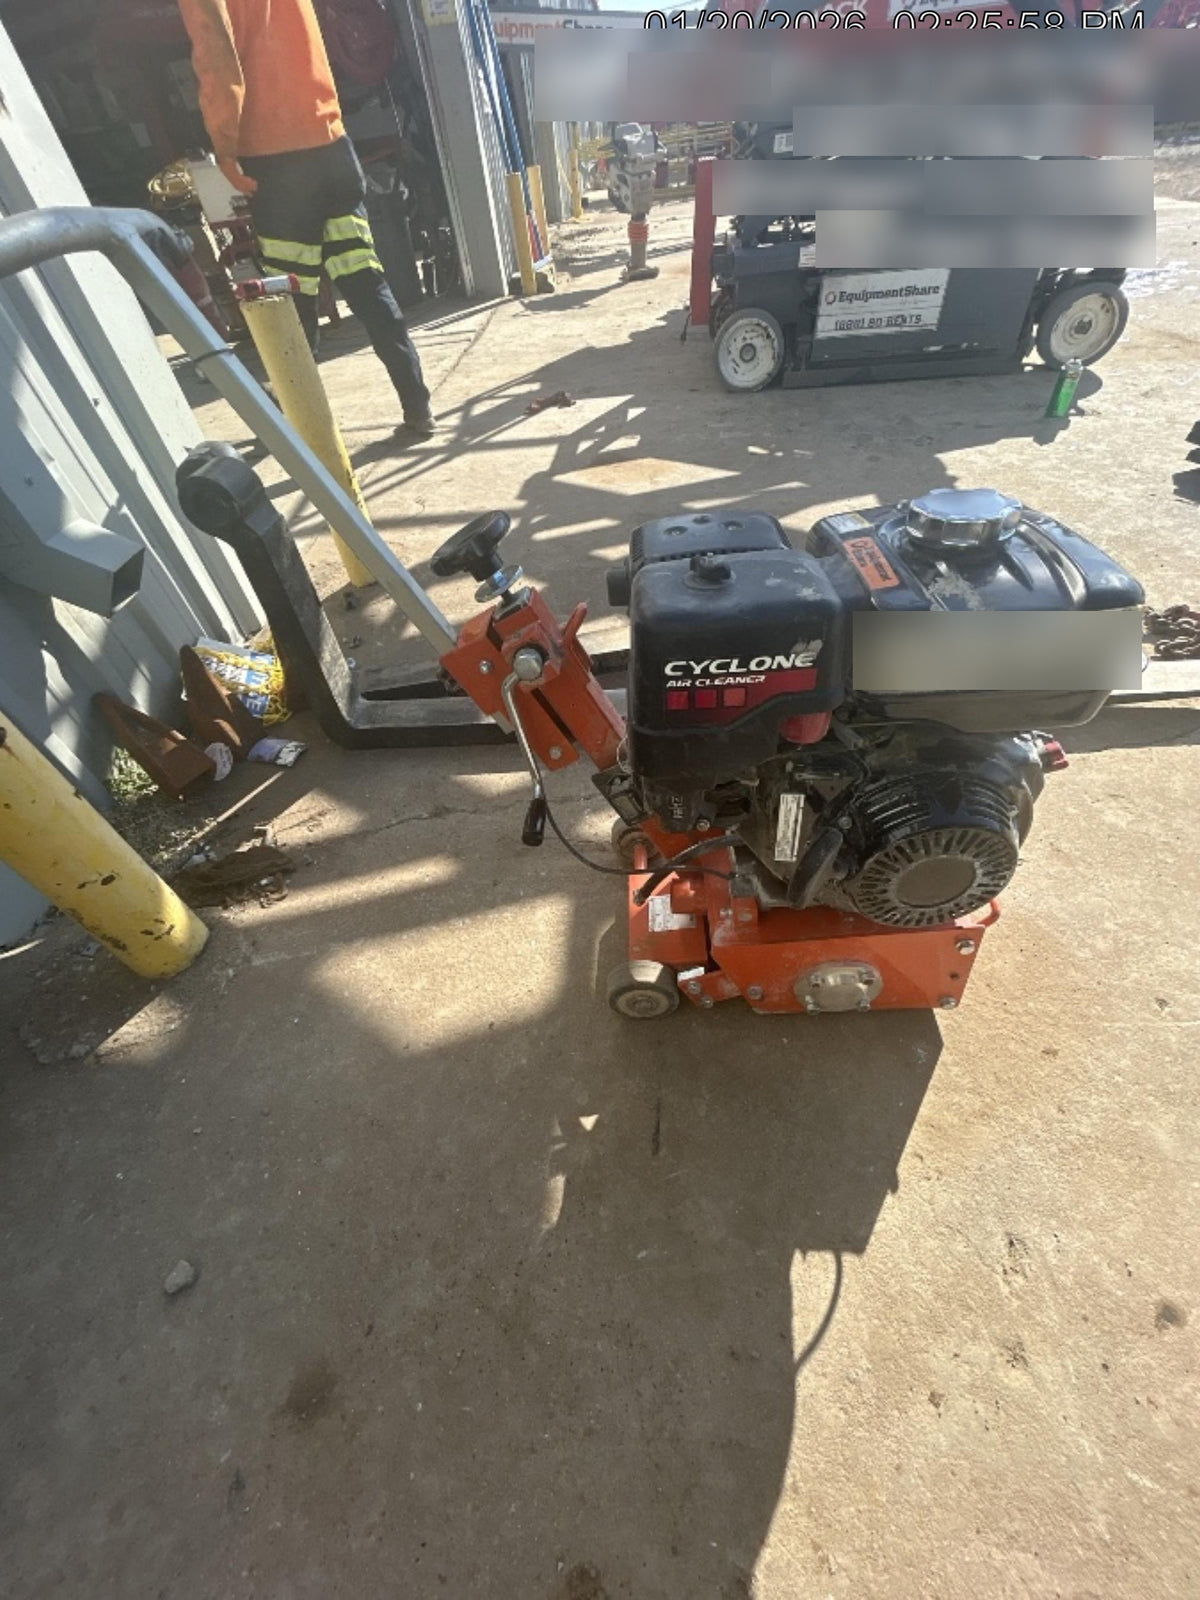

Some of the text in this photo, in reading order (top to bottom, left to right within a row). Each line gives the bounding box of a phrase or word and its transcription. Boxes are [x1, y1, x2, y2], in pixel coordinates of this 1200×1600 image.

[838, 284, 940, 304] EquipmentShare
[664, 651, 817, 677] CYCLONE
[666, 675, 768, 688] AIR CLEANER
